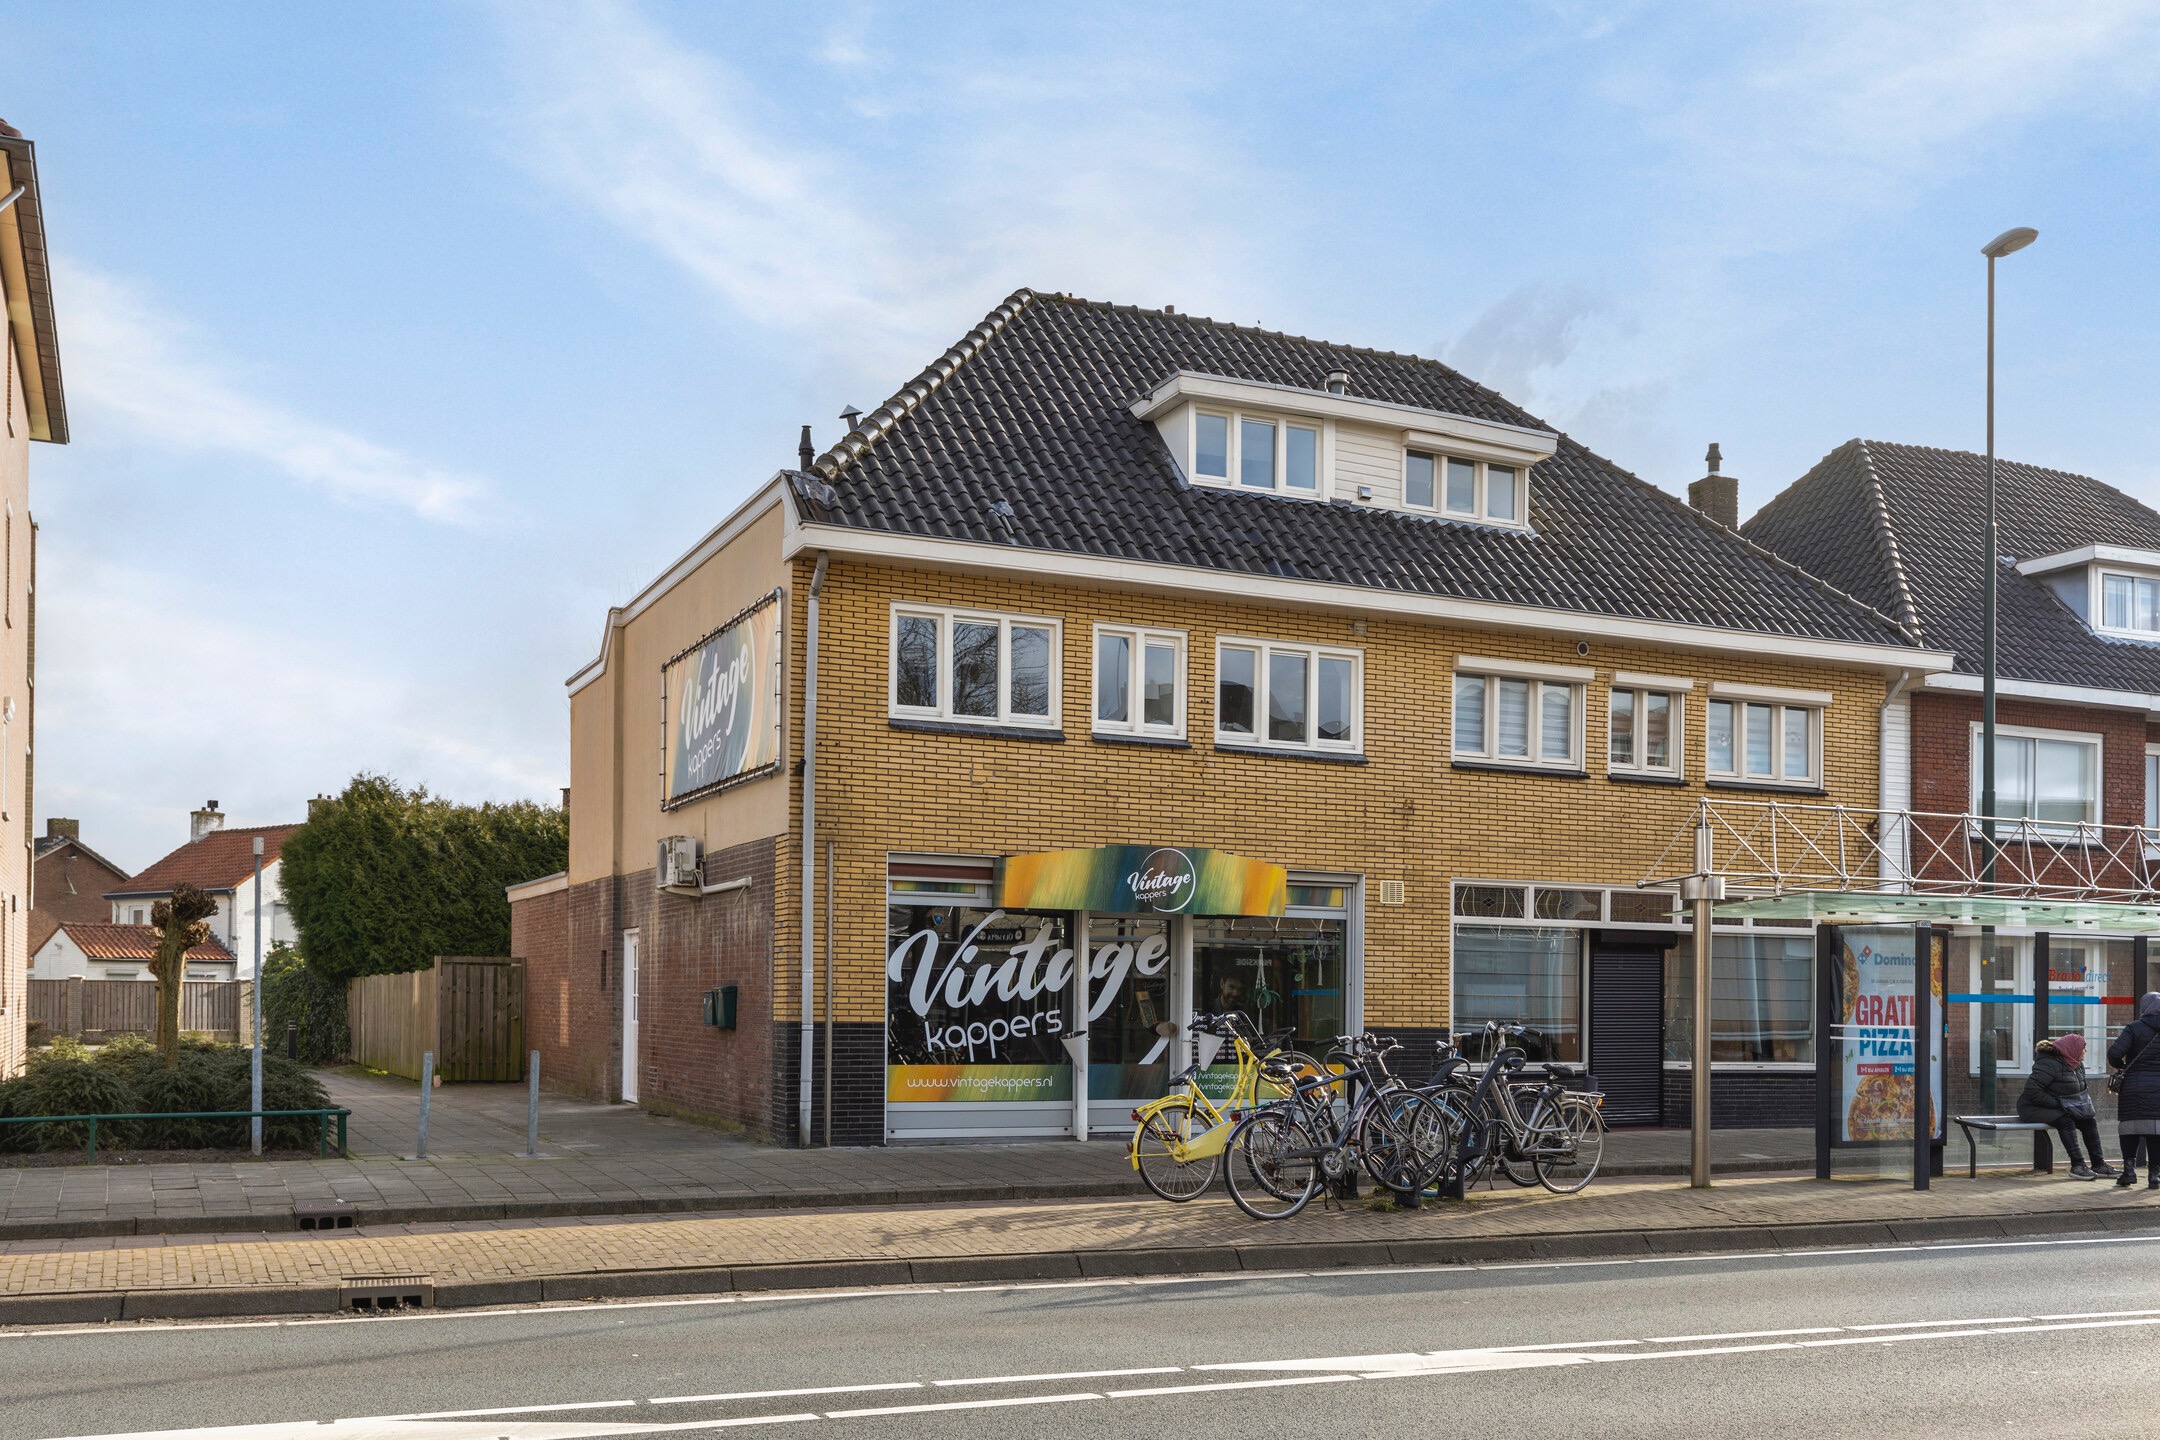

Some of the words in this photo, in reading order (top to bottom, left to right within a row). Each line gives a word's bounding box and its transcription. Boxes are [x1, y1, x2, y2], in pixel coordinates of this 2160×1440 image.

[681, 644, 749, 750] Vintage
[687, 730, 722, 782] kappers
[1127, 867, 1192, 894] Vintage
[1135, 890, 1167, 903] kappers
[888, 909, 1170, 1022] Vintage
[1874, 952, 1916, 966] Domino
[1855, 994, 1916, 1027] GRATI
[924, 1009, 1063, 1063] kappers
[1860, 1028, 1913, 1057] PIZZA
[907, 1075, 1053, 1093] www.vintagekappers.nl
